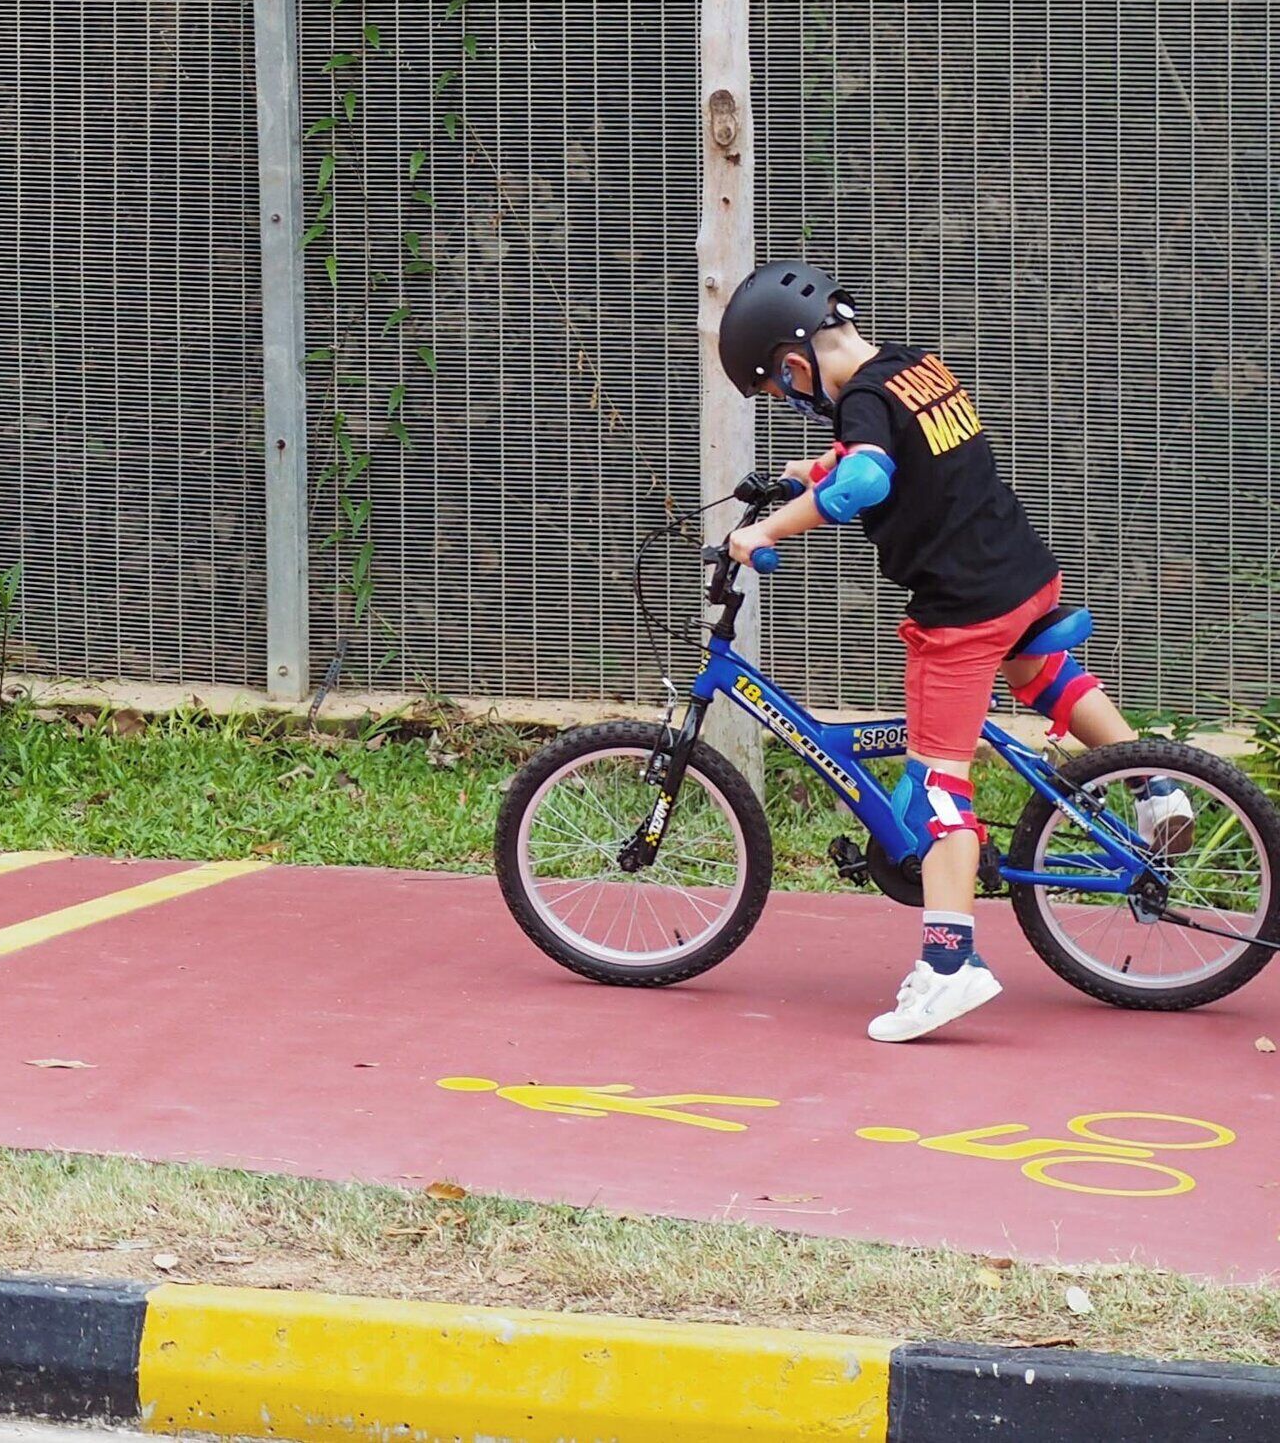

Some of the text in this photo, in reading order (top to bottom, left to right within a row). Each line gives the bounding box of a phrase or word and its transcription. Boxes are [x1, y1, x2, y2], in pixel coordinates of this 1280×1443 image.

[735, 675, 762, 703] 18
[800, 735, 858, 789] BIKE
[861, 725, 909, 748] SPOR
[923, 926, 963, 950] NY
